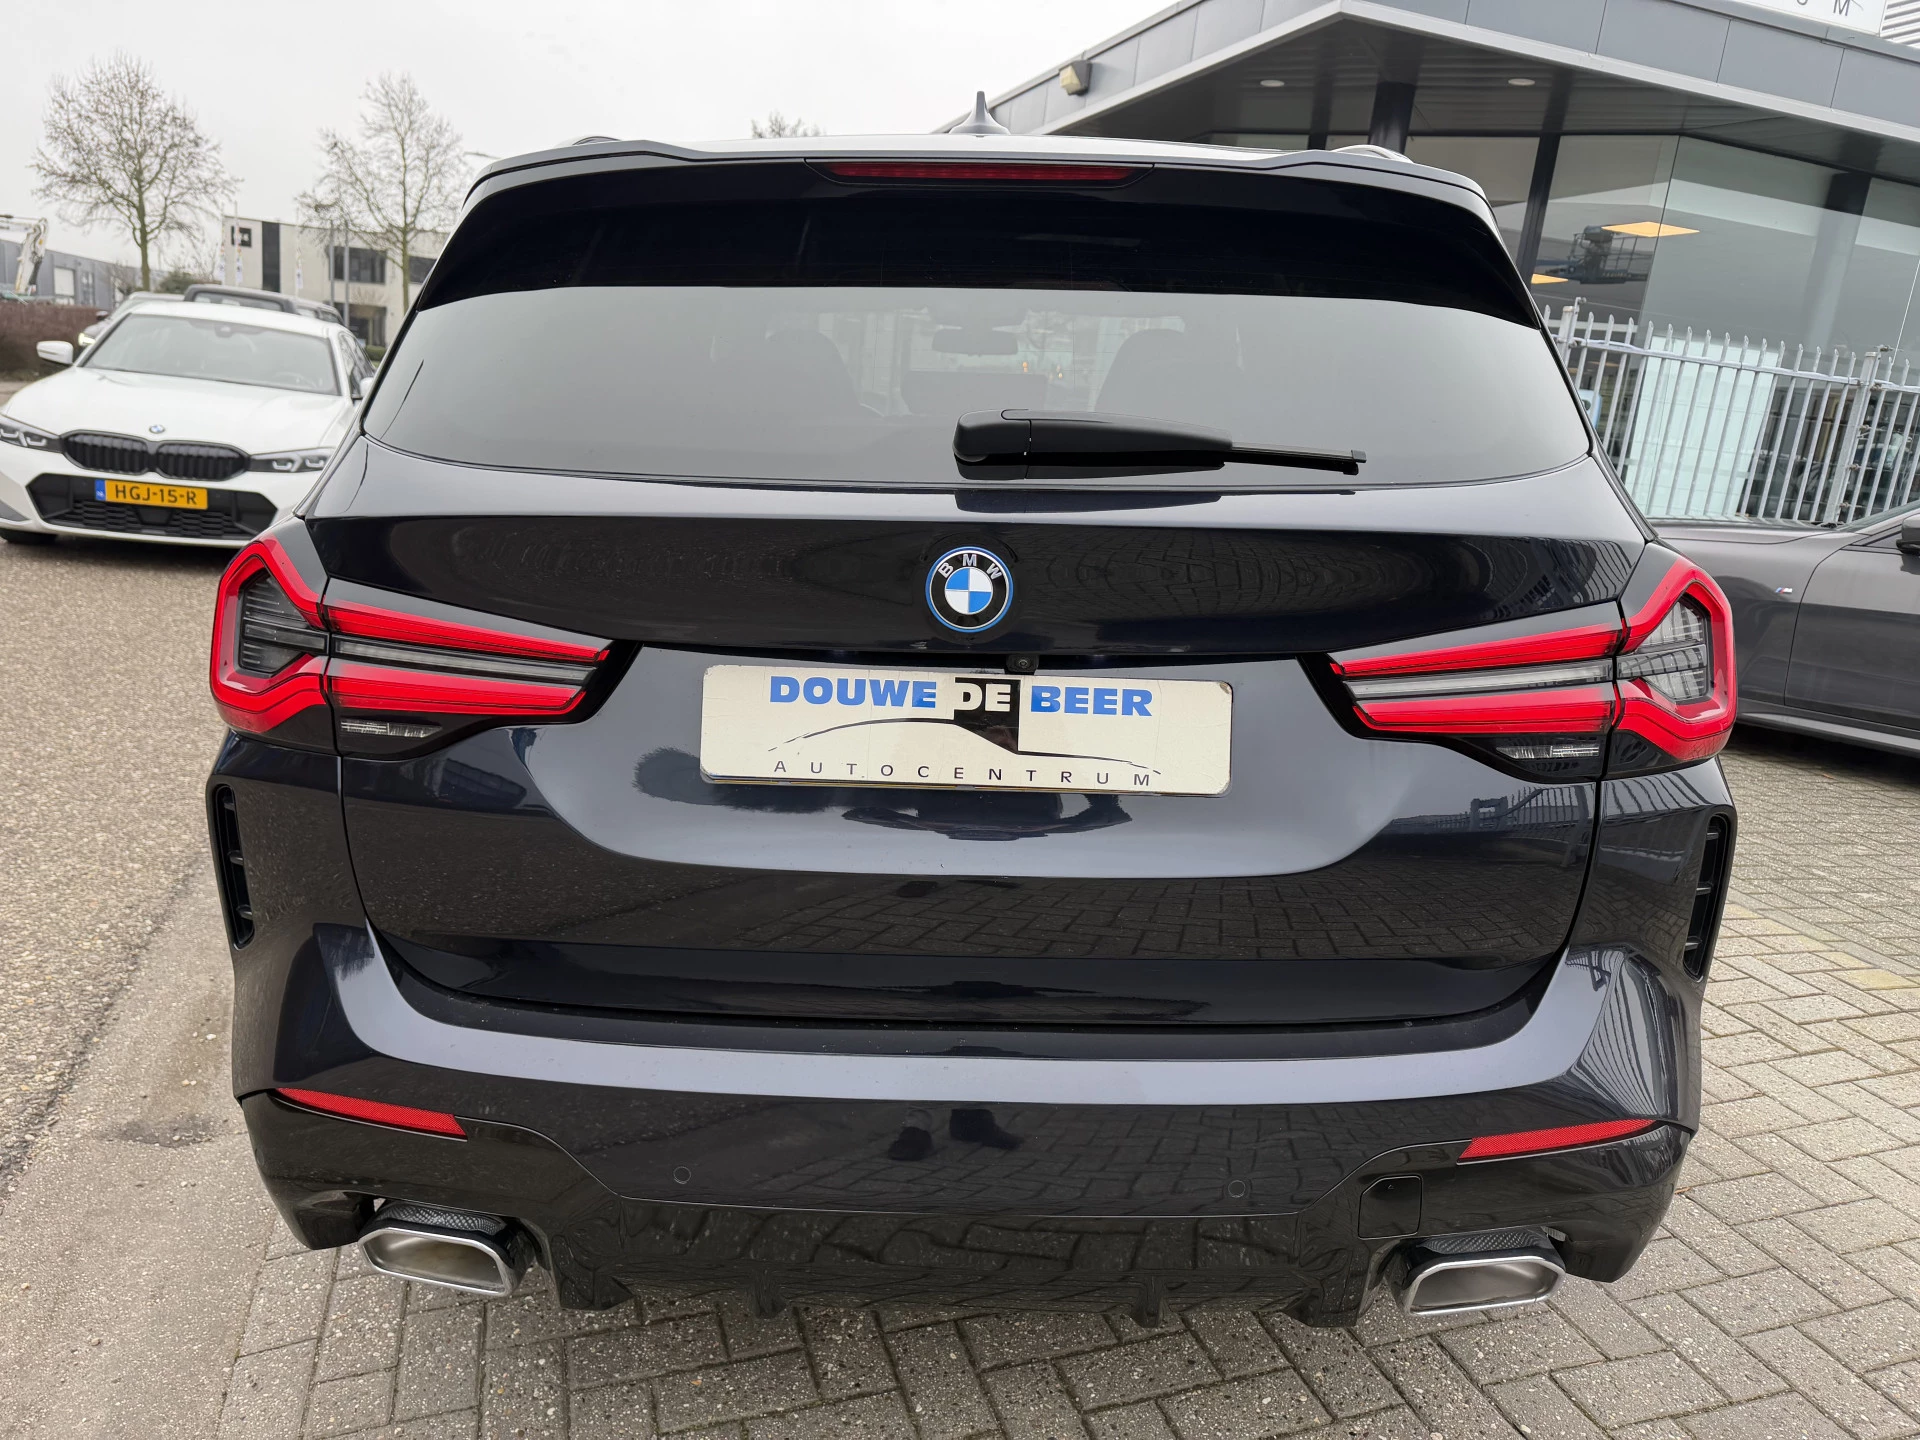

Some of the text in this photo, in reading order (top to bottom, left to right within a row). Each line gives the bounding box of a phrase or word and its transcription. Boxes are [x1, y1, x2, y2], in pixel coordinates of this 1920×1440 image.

[115, 484, 197, 505] HGJ-15-R
[938, 553, 1003, 580] BMW
[770, 676, 1153, 717] DOUWE DE BEER
[774, 760, 1150, 786] AUTOCENTRUM
